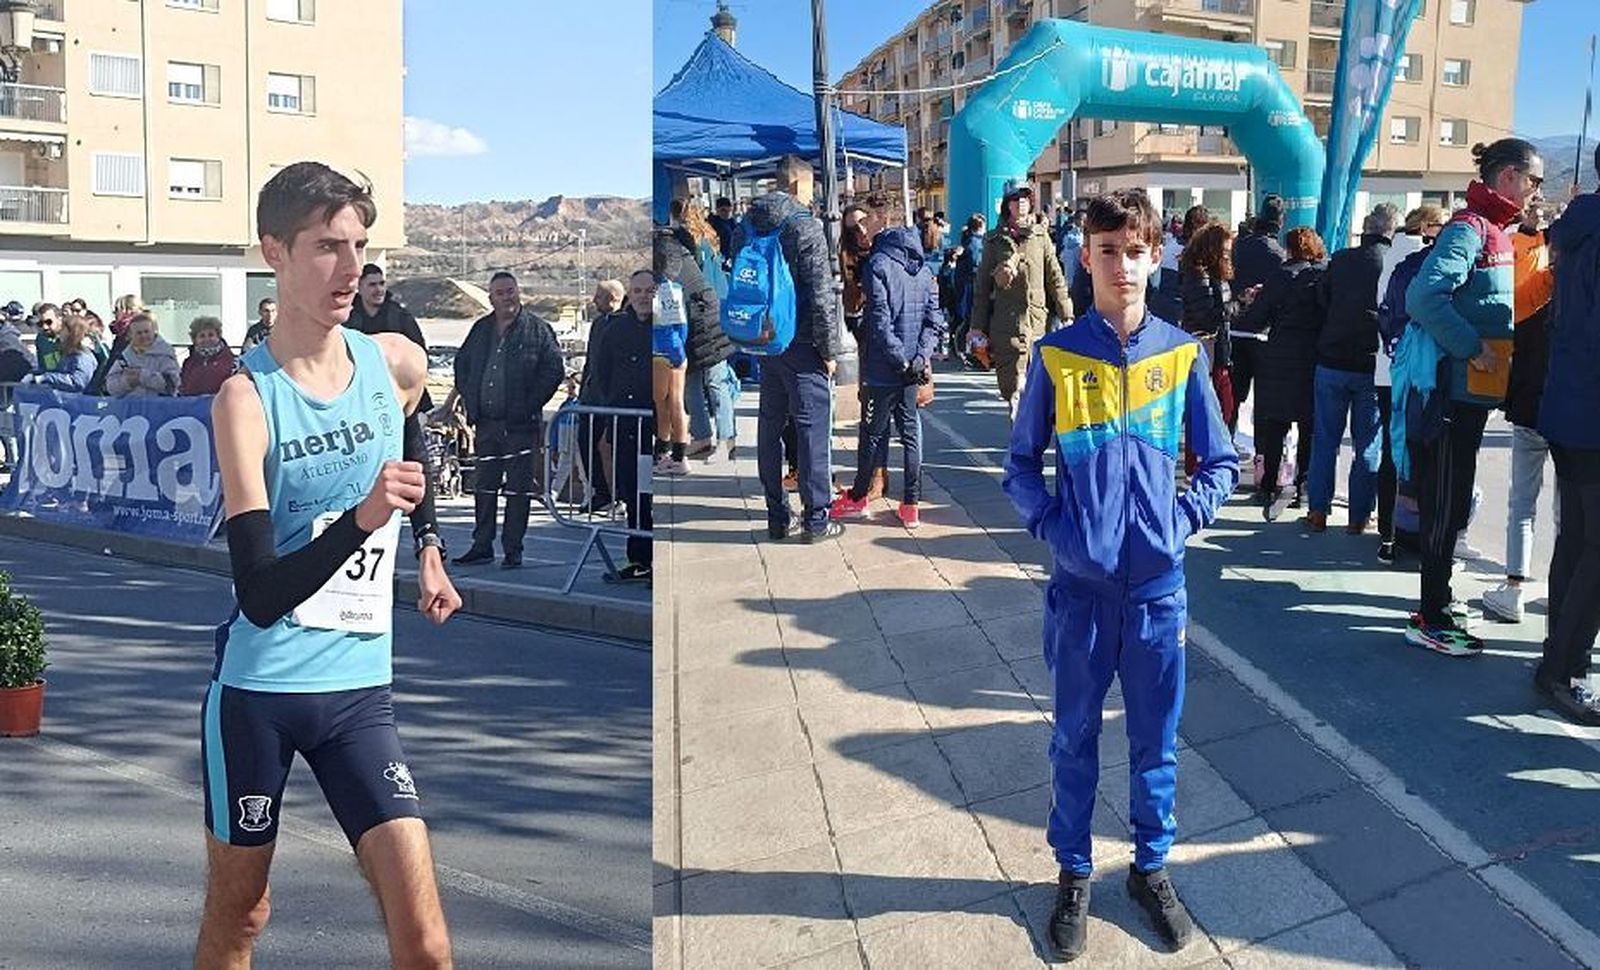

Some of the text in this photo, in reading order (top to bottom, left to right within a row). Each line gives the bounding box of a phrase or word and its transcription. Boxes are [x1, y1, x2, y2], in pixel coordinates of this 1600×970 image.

[1145, 55, 1243, 97] cajamar
[280, 420, 374, 462] nerja
[301, 453, 368, 480] ATLETISMO
[346, 547, 385, 581] 37
